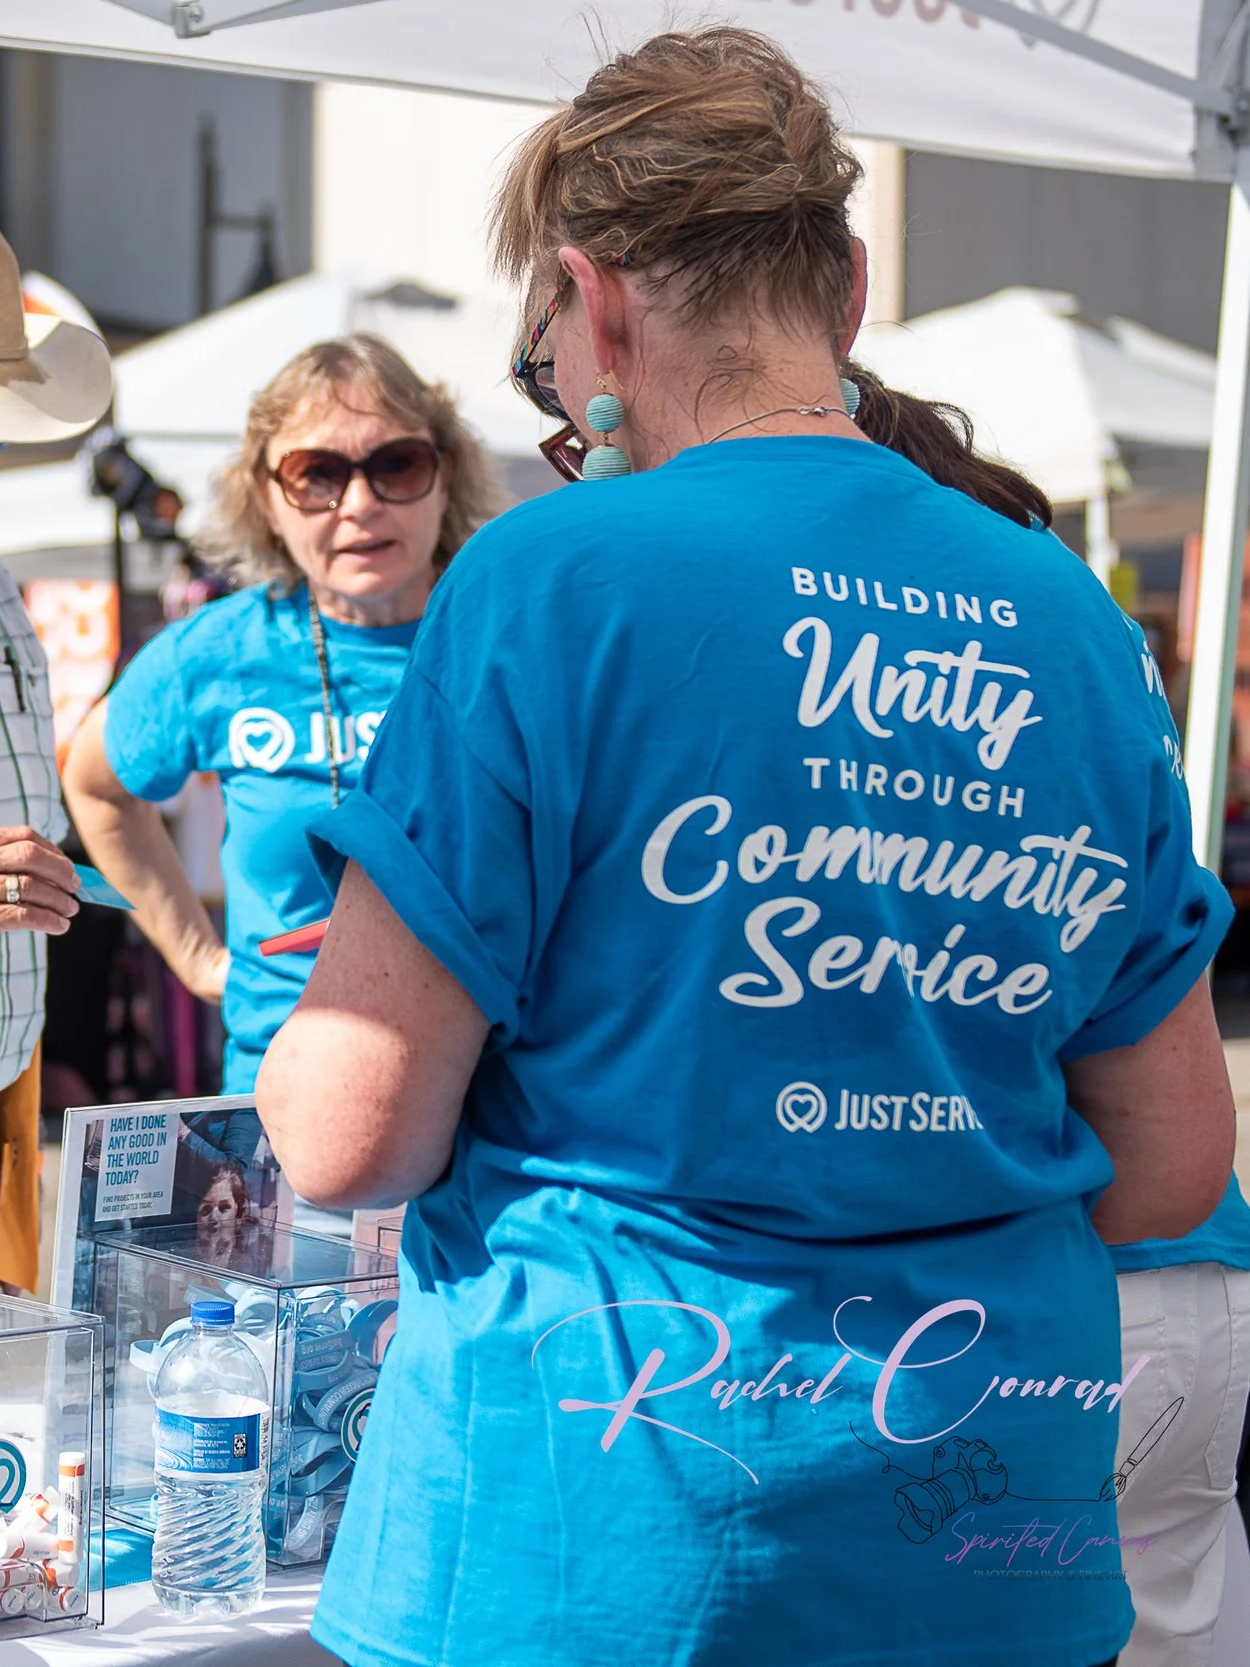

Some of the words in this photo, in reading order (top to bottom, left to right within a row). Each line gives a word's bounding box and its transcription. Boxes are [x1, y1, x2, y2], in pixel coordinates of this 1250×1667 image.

[791, 566, 1018, 628] BUILDING
[782, 616, 1043, 771] Unity
[303, 711, 388, 765] JUS
[803, 757, 1025, 818] THROUGH
[641, 795, 1129, 953] Community
[719, 896, 1053, 1015] Service
[108, 1135, 127, 1150] ANY
[129, 1133, 155, 1148] GOOD
[157, 1132, 167, 1146] IN
[110, 1117, 134, 1132] HAVE
[136, 1116, 140, 1130] I
[141, 1114, 167, 1129] DONE
[105, 1170, 140, 1186] TODAY?
[107, 1153, 125, 1168] THE
[126, 1150, 159, 1166] WORLD
